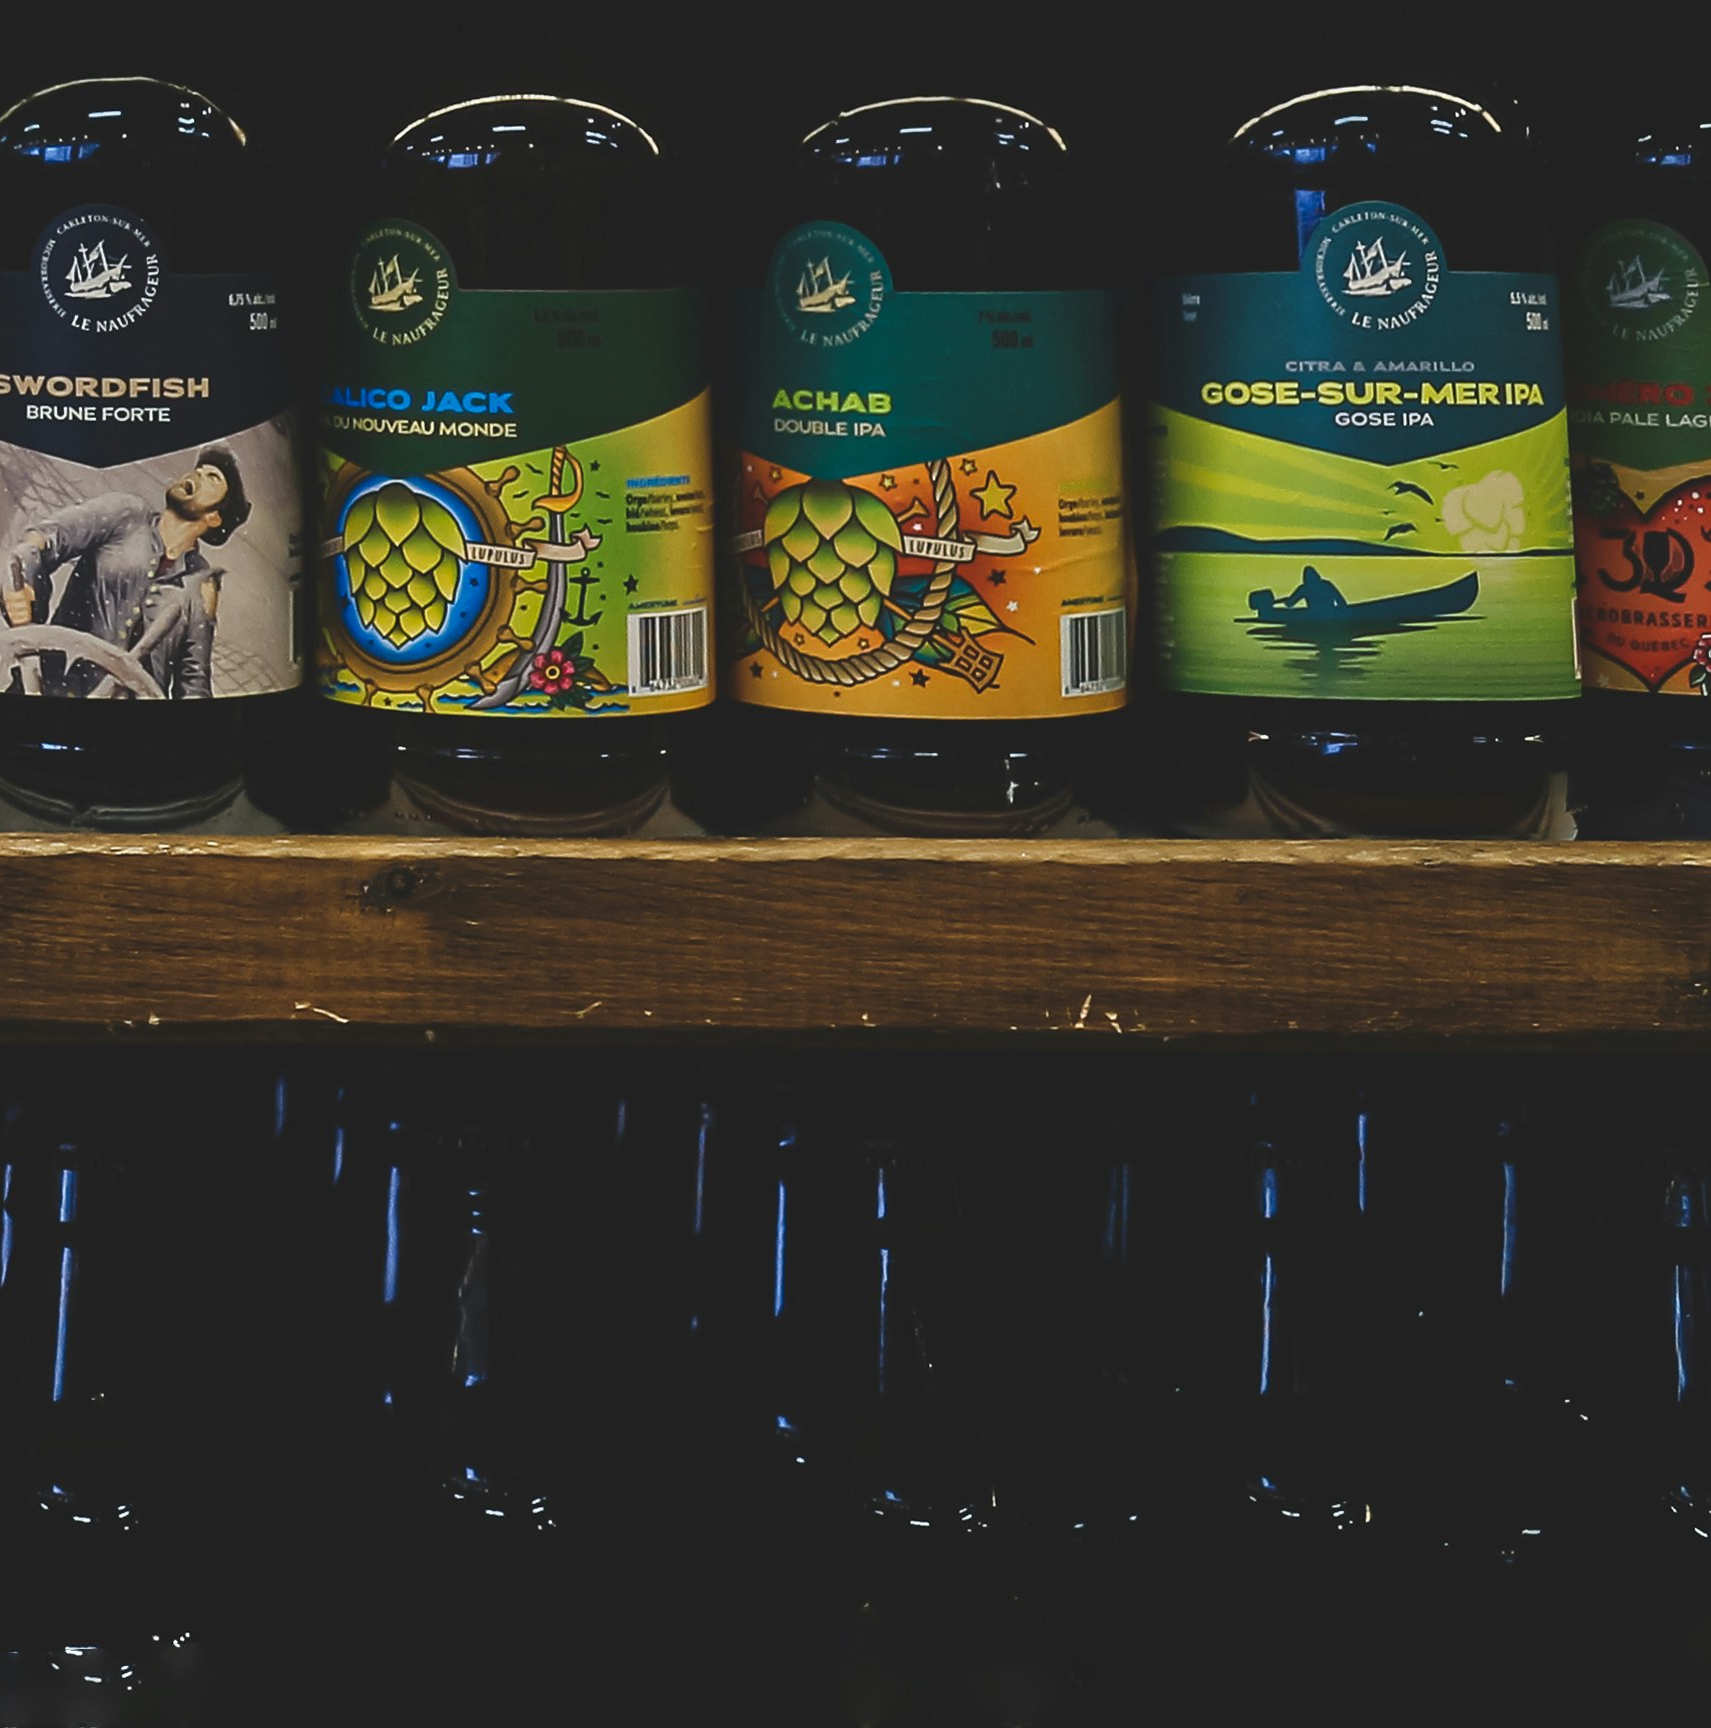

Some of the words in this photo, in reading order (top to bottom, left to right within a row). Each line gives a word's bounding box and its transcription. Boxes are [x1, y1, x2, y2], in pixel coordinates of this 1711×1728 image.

[95, 253, 161, 334] NAUFRAGEUR
[1377, 249, 1440, 331] NAUFRAGEUR
[391, 267, 451, 347] NAUFRAGEUR
[821, 268, 883, 347] NAUFRAGEUR
[1285, 360, 1345, 373] CITRA
[1373, 360, 1476, 373] AMARILLO
[421, 390, 515, 414] JACK
[772, 388, 893, 415] ACHAB
[1201, 381, 1502, 407] GOSE-SUR-MER
[26, 404, 98, 422] BRUNE
[101, 406, 172, 424] FORTE
[1334, 412, 1396, 428] GOSE
[1401, 412, 1435, 427] IPA
[1609, 411, 1661, 428] PALE
[352, 417, 433, 437] NOUVEAU
[438, 420, 518, 440] MONDE
[774, 418, 849, 438] DOUBLE
[853, 421, 888, 438] IPA
